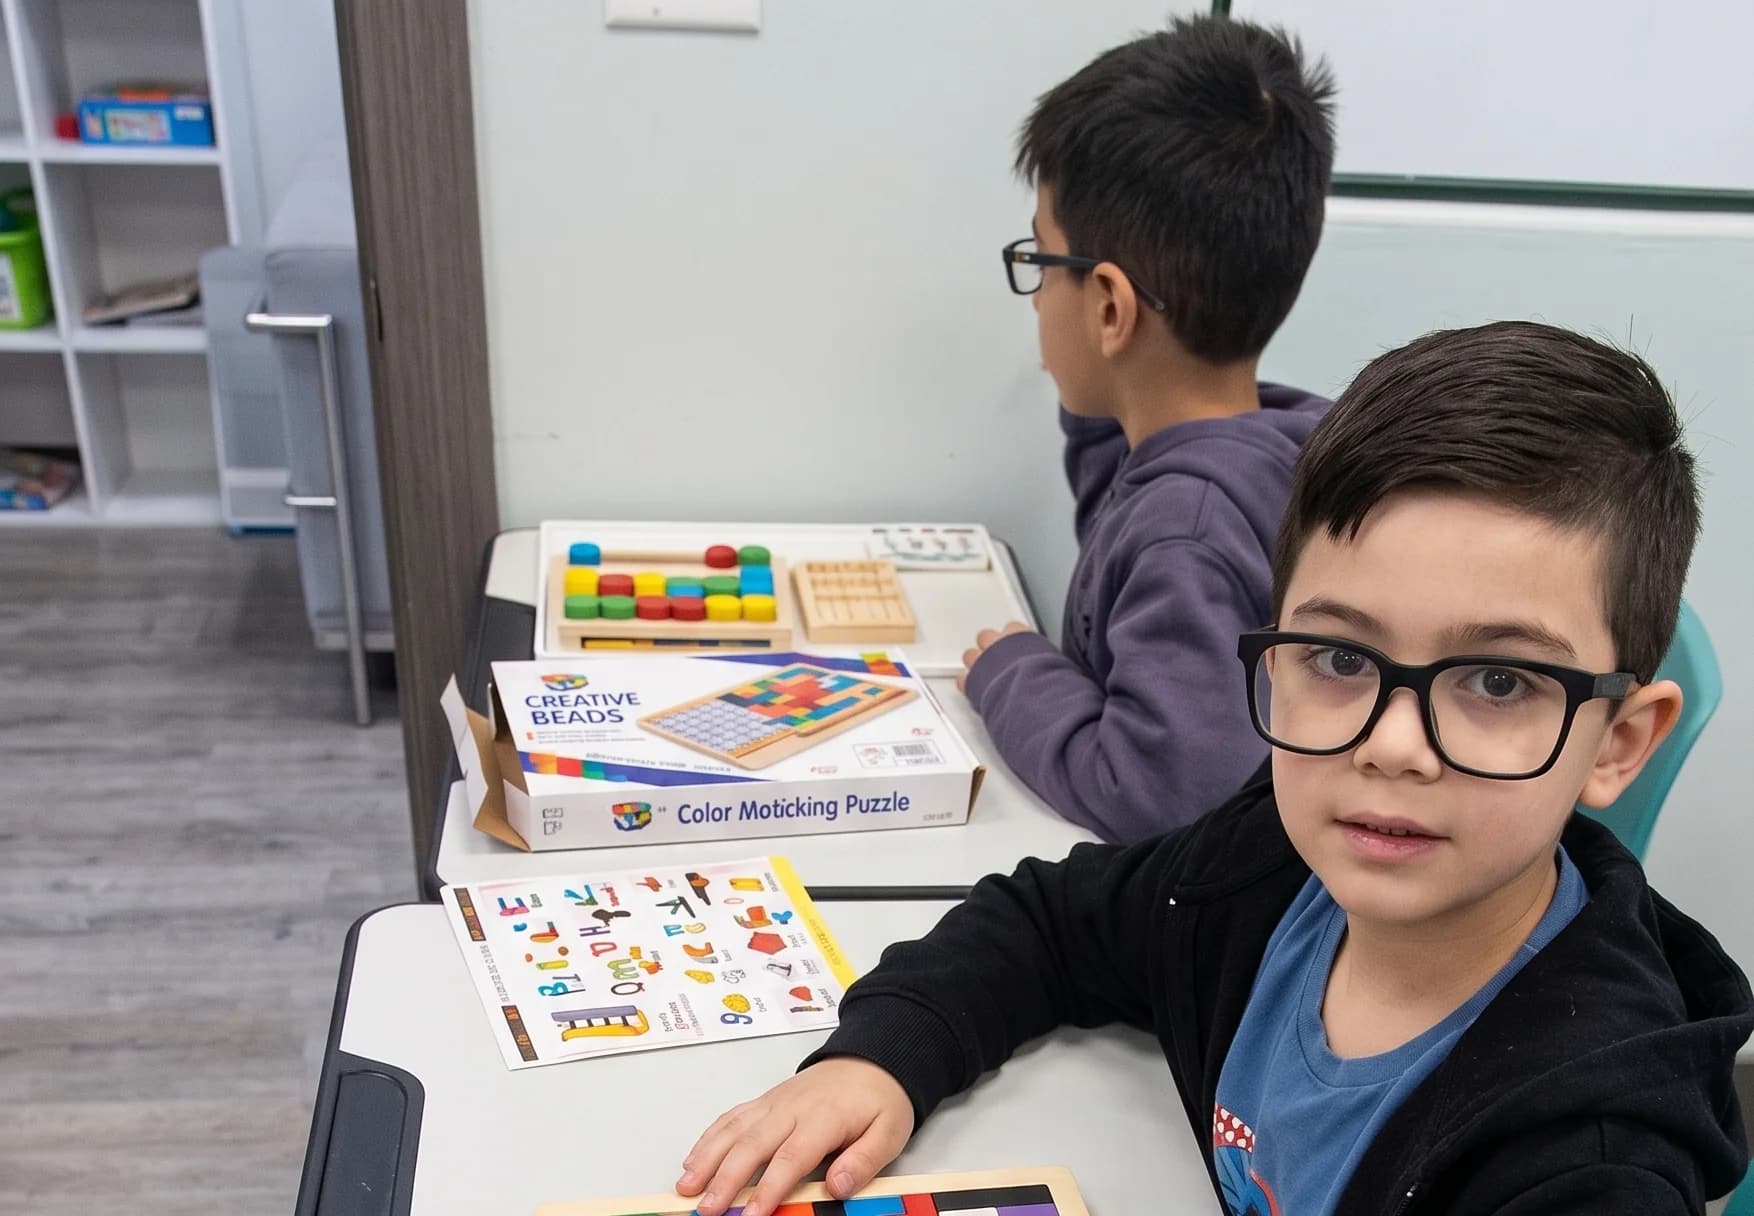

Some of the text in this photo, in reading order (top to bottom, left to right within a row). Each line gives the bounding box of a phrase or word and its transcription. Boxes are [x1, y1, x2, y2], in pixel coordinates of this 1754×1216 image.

[525, 691, 641, 708] CREATIVE
[532, 709, 624, 725] BEADS
[678, 790, 910, 824] Color Moticking Puzzle
